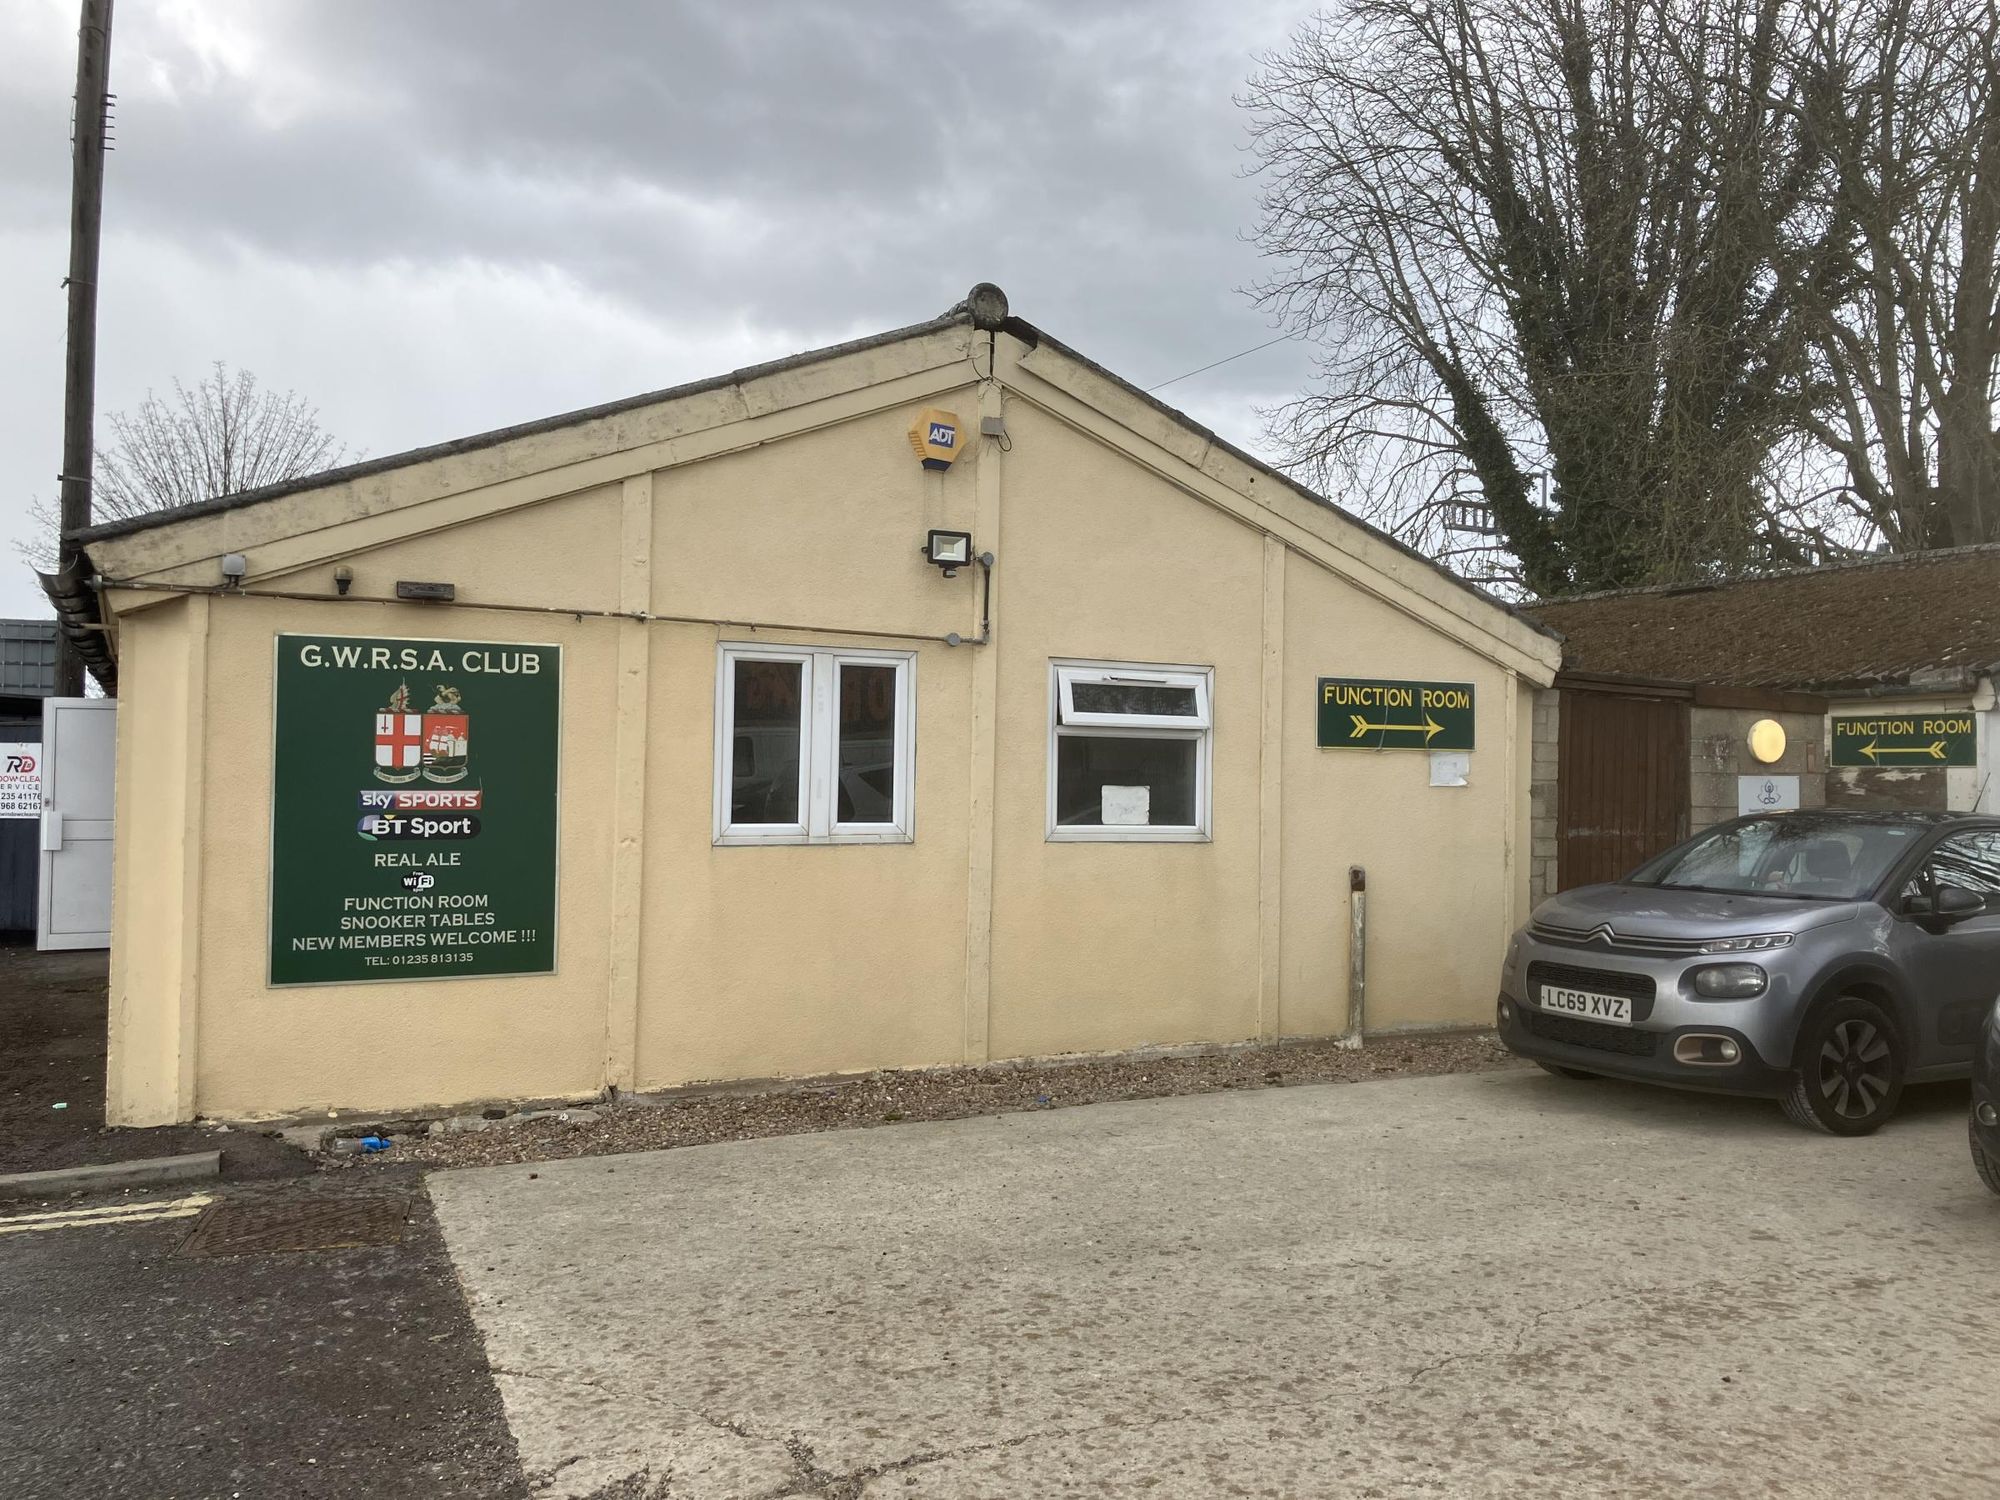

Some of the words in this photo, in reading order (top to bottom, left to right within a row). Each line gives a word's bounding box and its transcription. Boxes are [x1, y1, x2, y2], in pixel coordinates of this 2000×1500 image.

[929, 427, 955, 444] ADT
[300, 644, 454, 672] G.W.R.S.A.
[462, 651, 540, 674] CLUB
[1324, 686, 1412, 707] FUNCTION
[1422, 690, 1470, 709] ROOM
[1836, 721, 1914, 736] FUNCTION
[1923, 719, 1972, 735] ROOM
[7, 756, 36, 772] RD
[362, 792, 392, 809] sky
[399, 793, 477, 808] SPORTS
[372, 819, 407, 835] BT
[411, 817, 471, 838] Sport
[374, 853, 422, 867] REAL
[426, 853, 461, 866] ALE
[344, 896, 434, 911] FUNCTION
[438, 895, 488, 908] ROOM
[340, 914, 426, 930] SNOOKER
[430, 913, 495, 927] TABLES
[292, 936, 335, 951] NEW
[339, 934, 426, 949] MEMBERS
[430, 930, 517, 946] WELCOME
[521, 930, 536, 942] !!!
[364, 956, 390, 966] TEL:
[392, 954, 429, 965] 01235
[431, 953, 474, 964] 813135
[1548, 989, 1586, 1012] LC69
[1591, 996, 1624, 1018] XVZ
